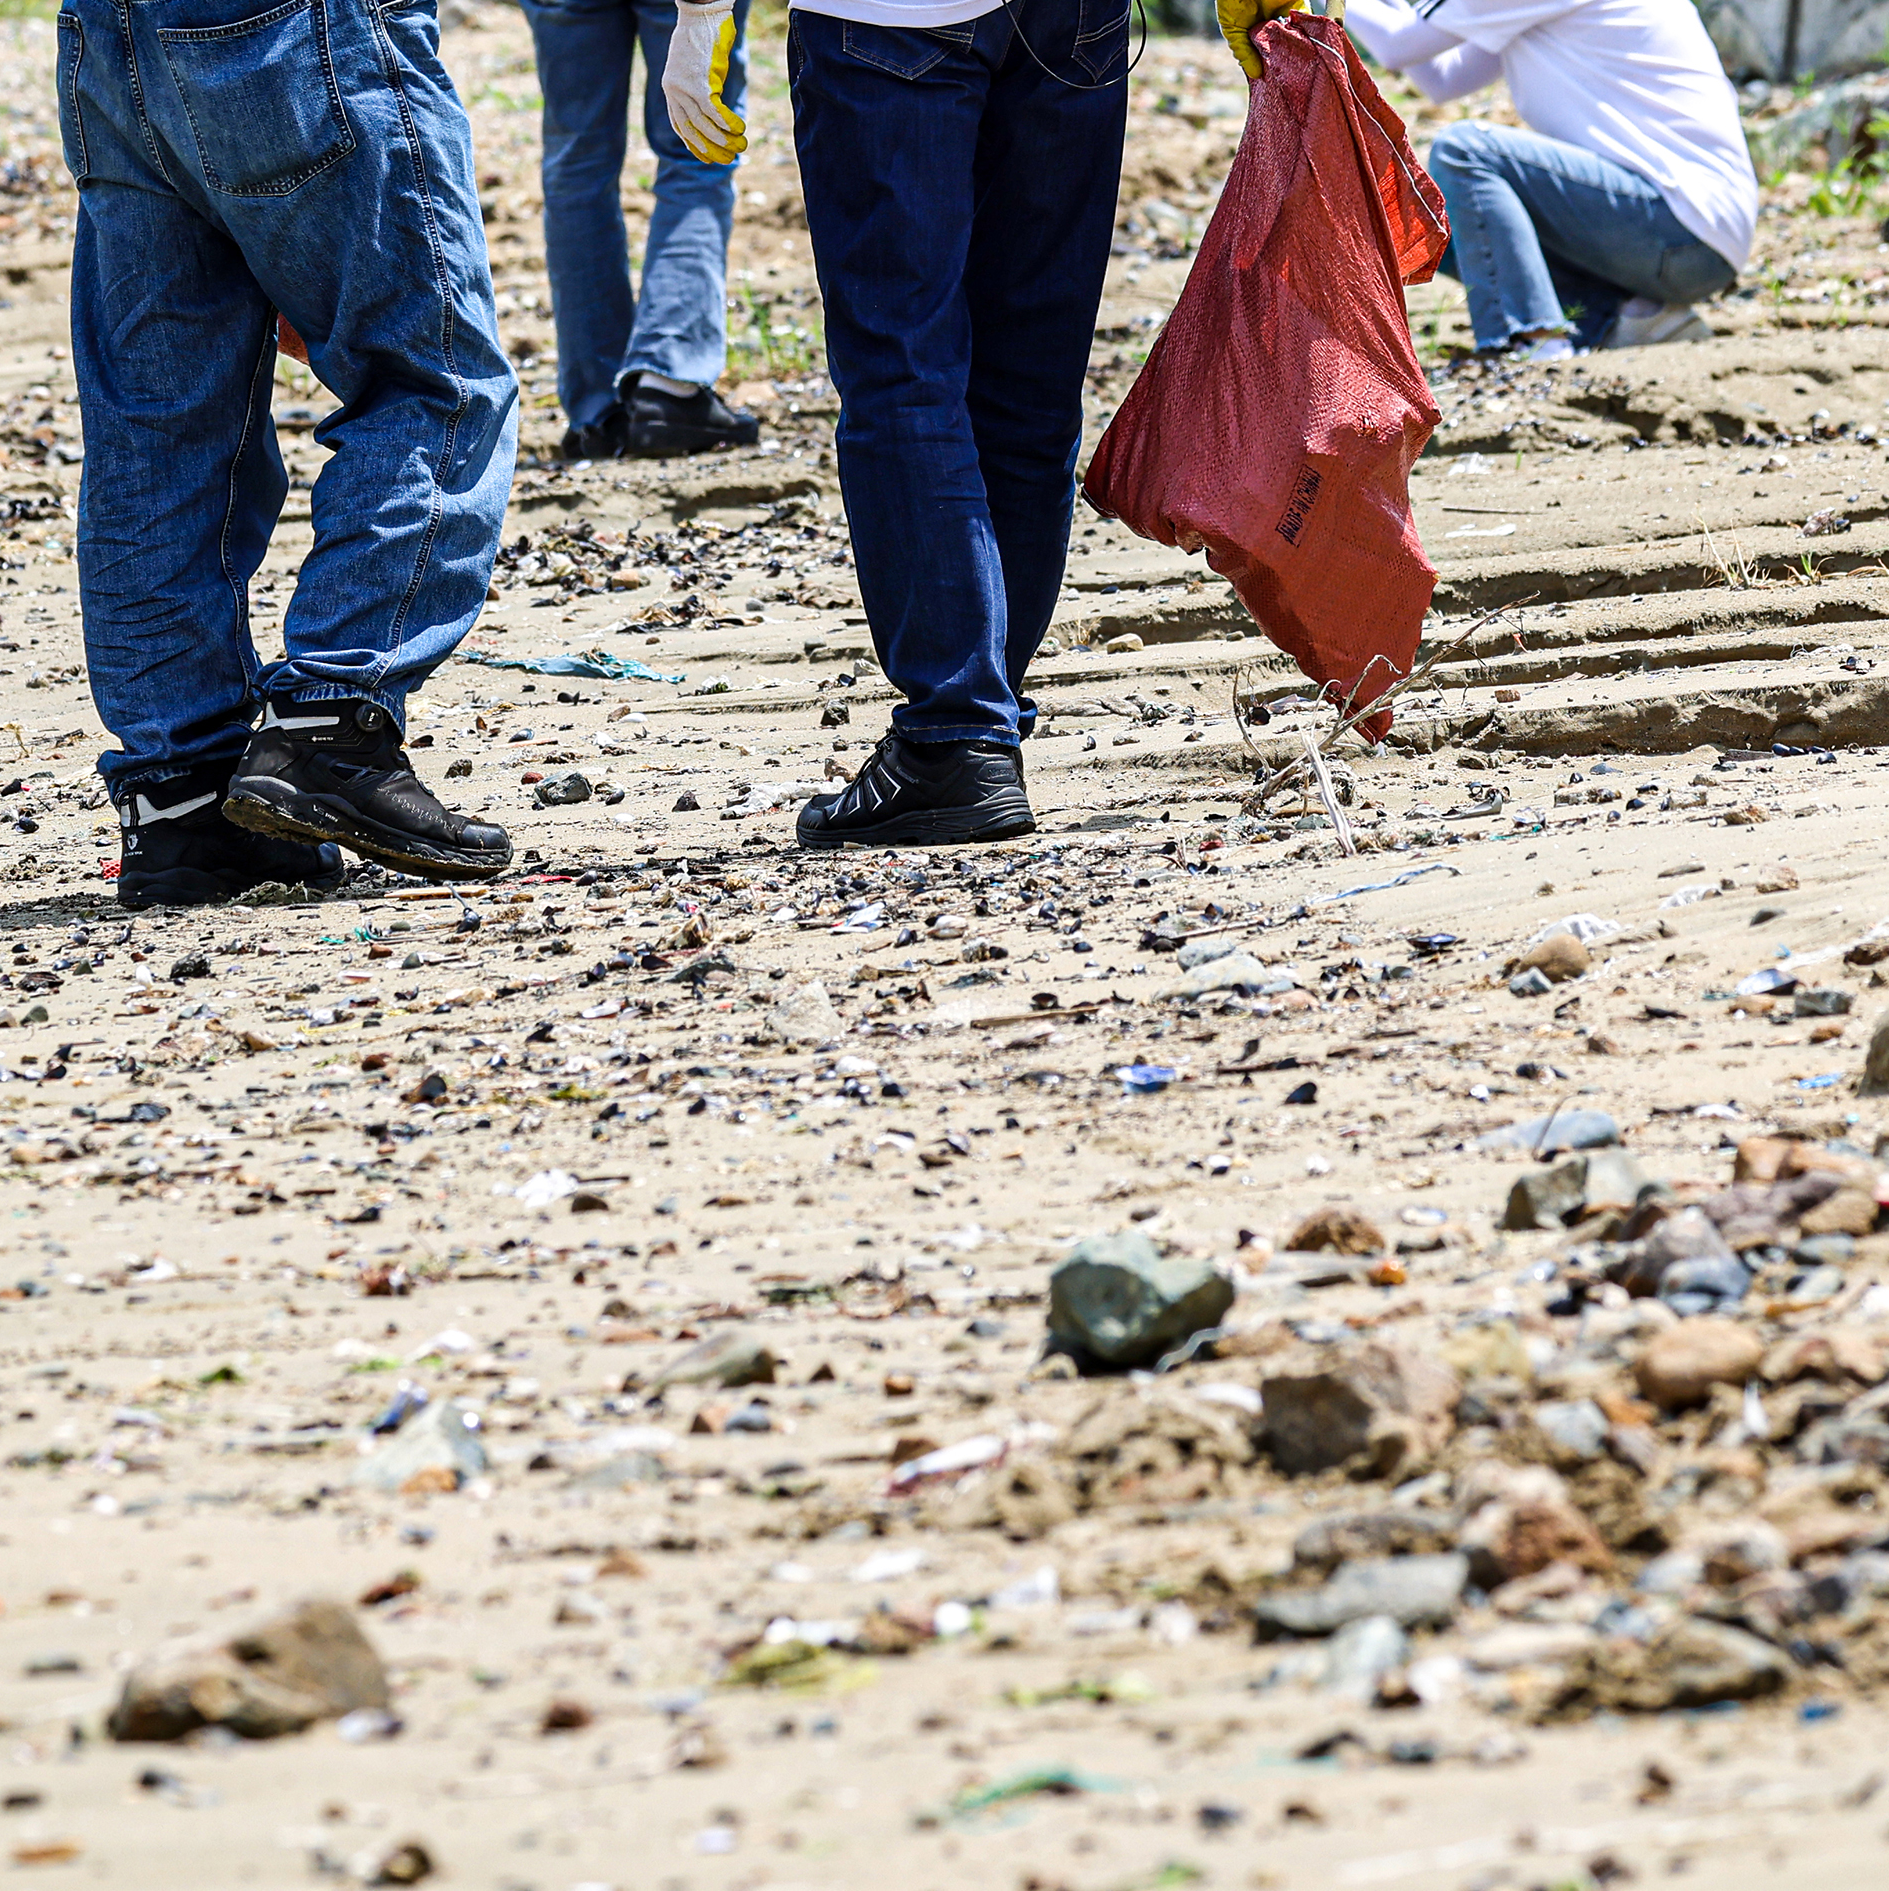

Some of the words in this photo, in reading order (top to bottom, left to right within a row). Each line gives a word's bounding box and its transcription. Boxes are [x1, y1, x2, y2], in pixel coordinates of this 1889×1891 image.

[1297, 470, 1322, 505] CHINA
[1291, 497, 1311, 515] IN
[1279, 507, 1303, 539] MADE
